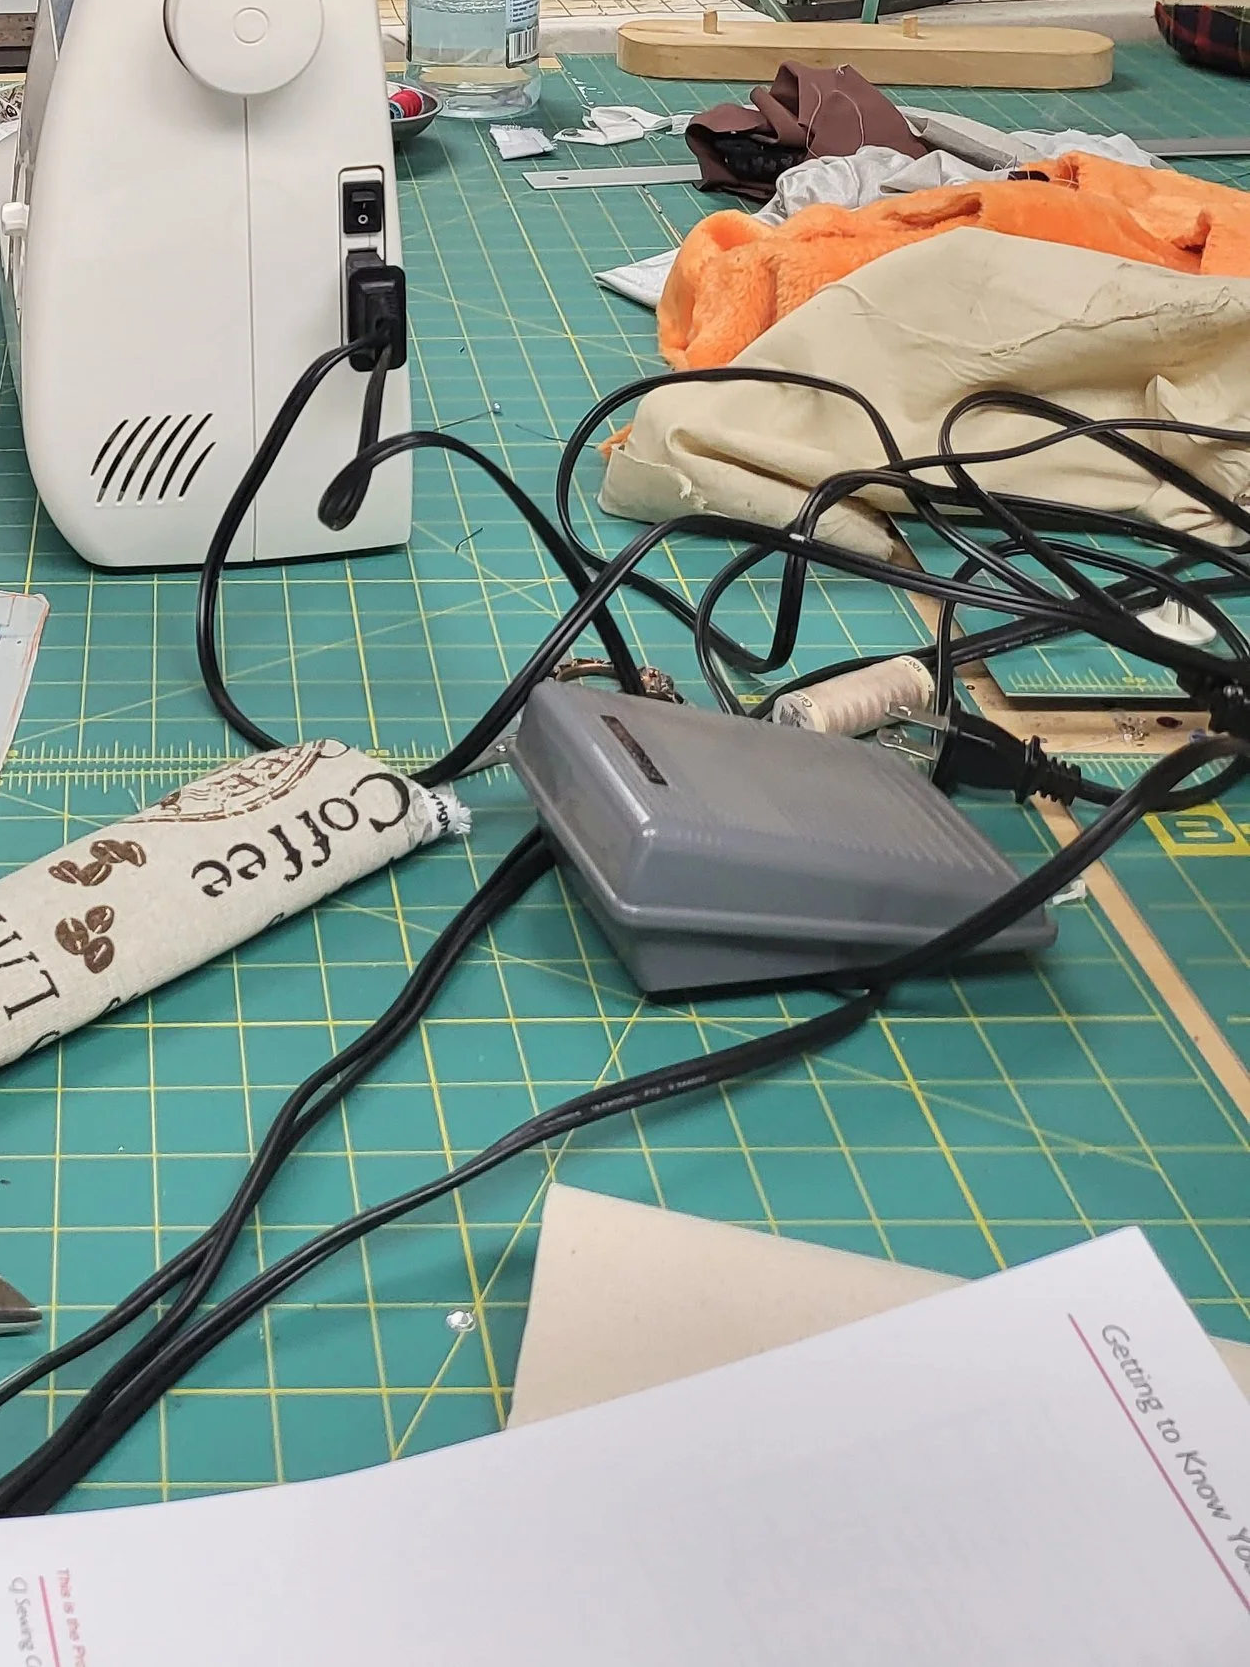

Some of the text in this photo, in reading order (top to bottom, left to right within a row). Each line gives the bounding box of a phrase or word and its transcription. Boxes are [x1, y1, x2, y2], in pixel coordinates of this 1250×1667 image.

[191, 770, 411, 899] Coffee
[1101, 1323, 1250, 1576] Getting to Know Yo
[62, 1601, 75, 1615] is
[66, 1617, 81, 1642] the
